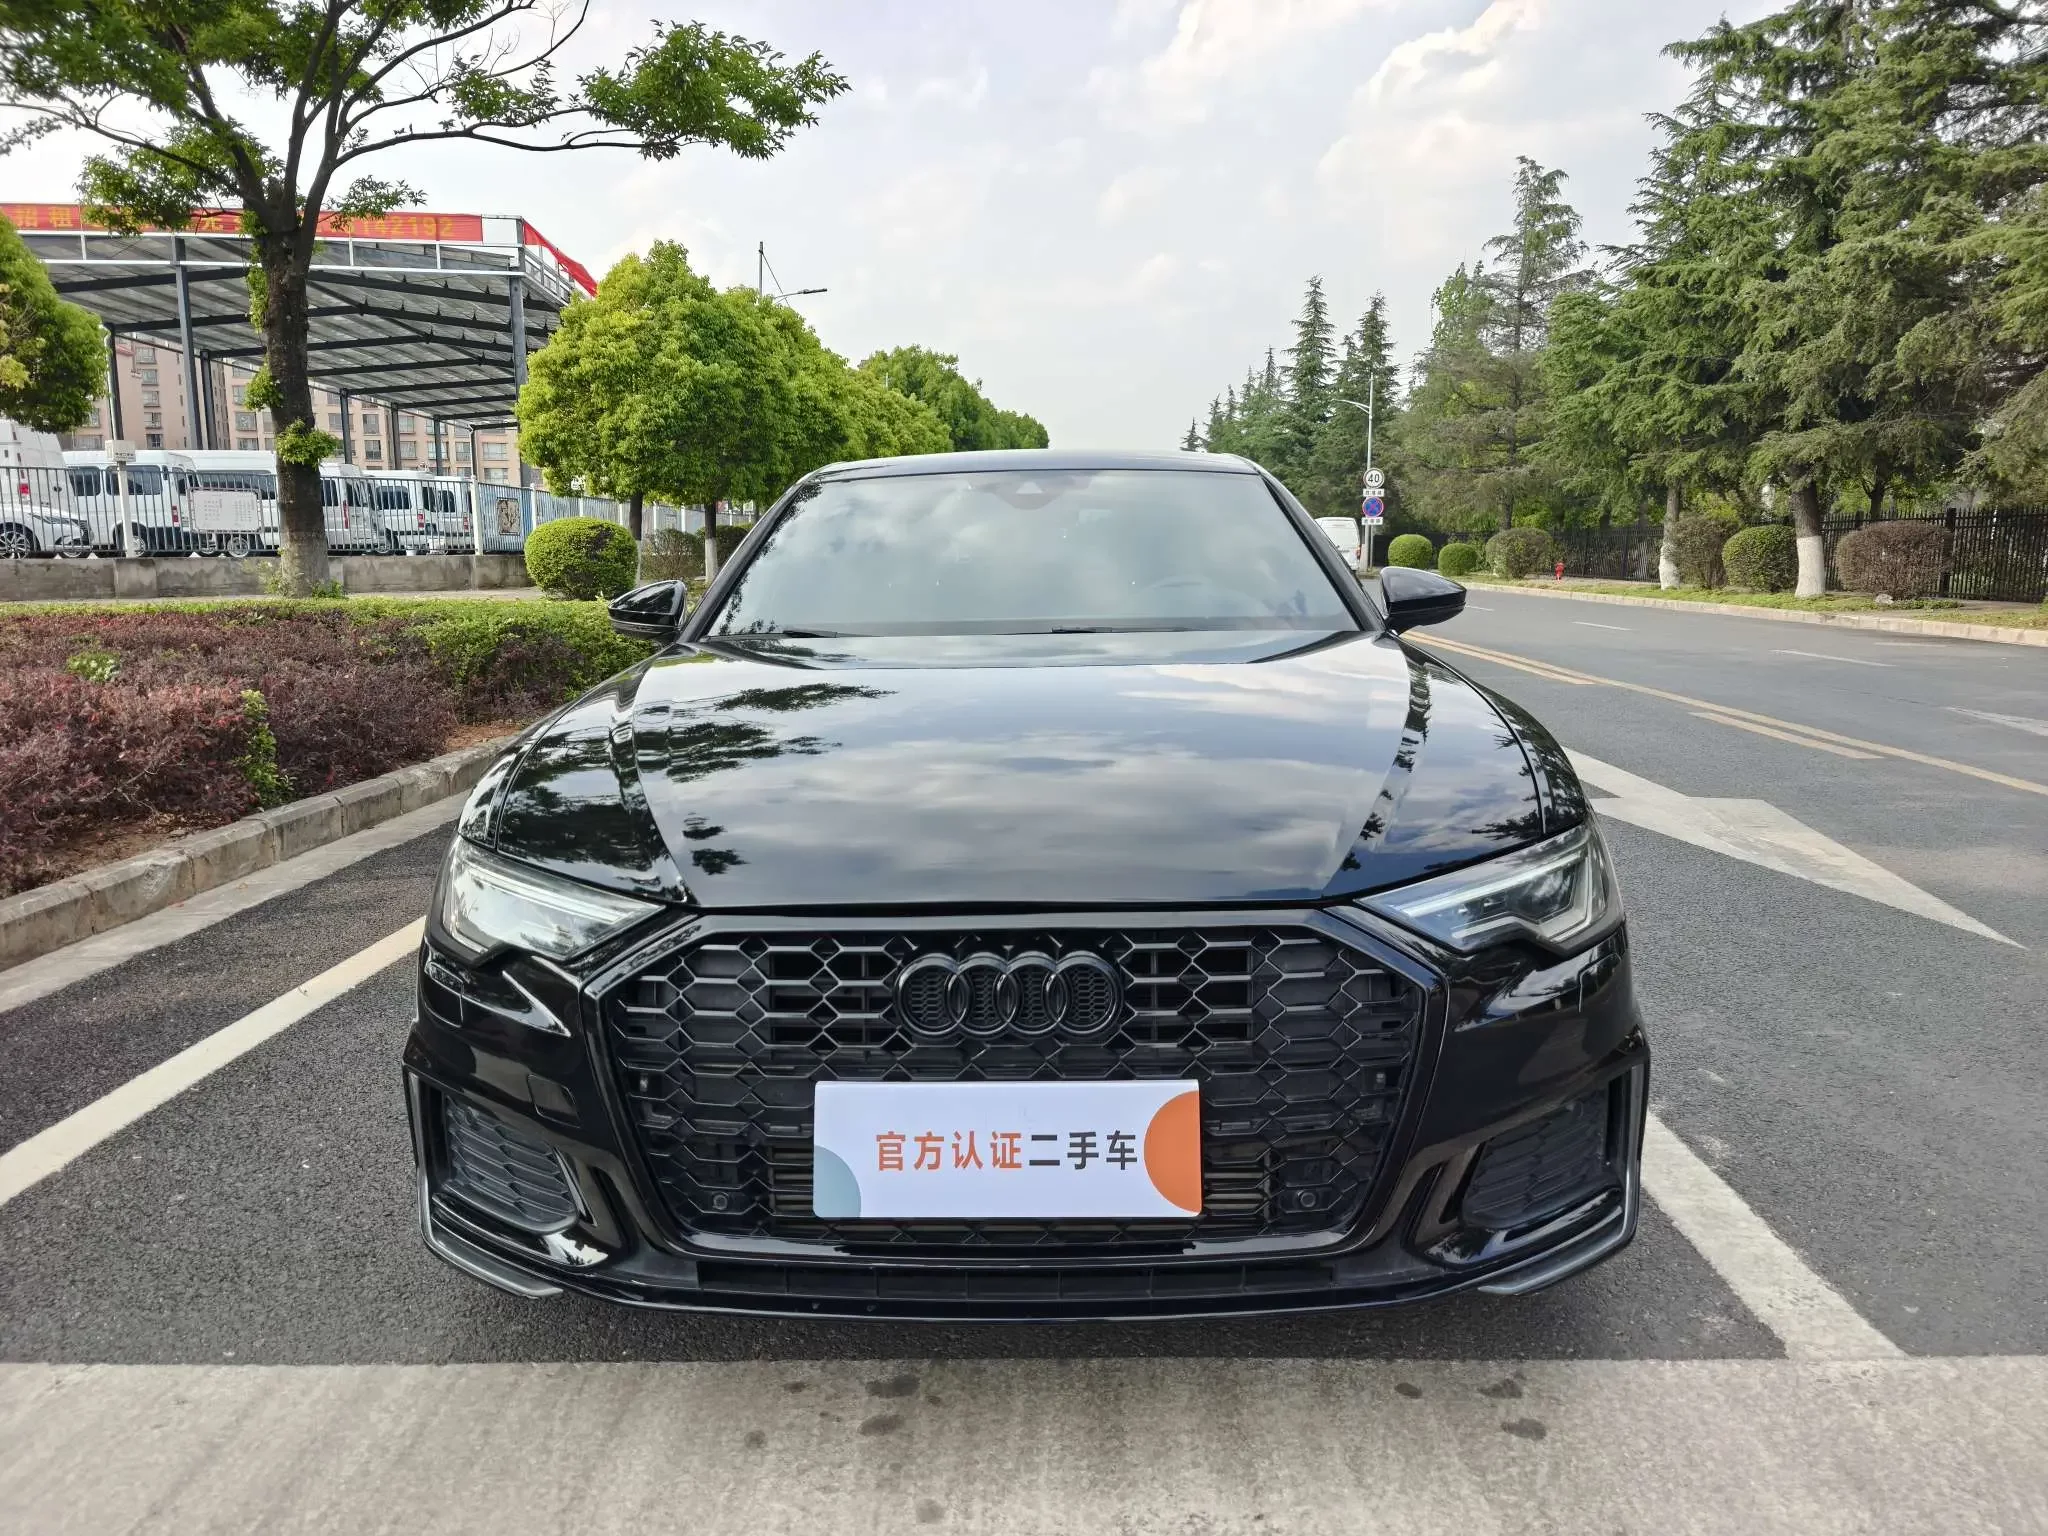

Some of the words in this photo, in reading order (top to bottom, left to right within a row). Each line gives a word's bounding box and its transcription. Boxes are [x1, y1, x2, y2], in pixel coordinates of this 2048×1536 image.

[1367, 473, 1380, 483] 40
[876, 1130, 1138, 1171] 官方认证二手车
